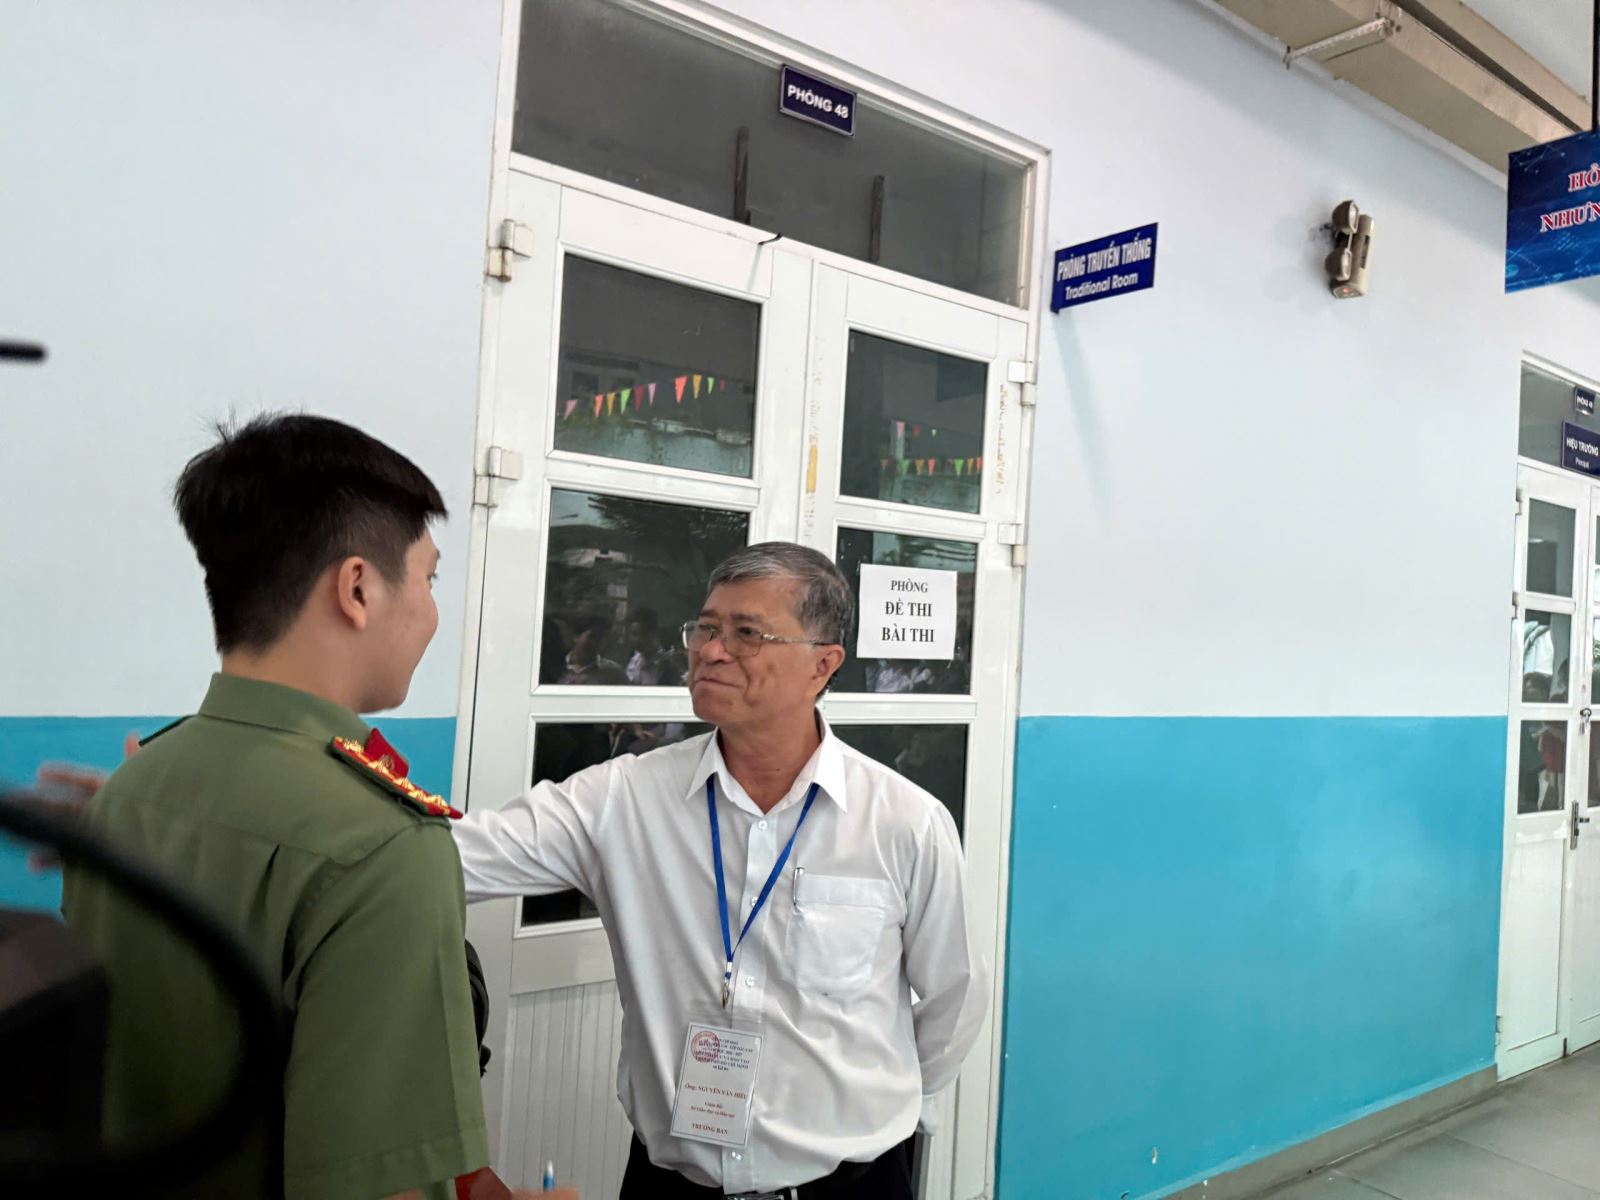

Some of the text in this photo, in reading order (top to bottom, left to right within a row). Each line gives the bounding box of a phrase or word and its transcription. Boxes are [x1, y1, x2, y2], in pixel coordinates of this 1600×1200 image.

[787, 84, 849, 119] PHÒNG 48
[1056, 253, 1086, 282] PHÒNG
[1121, 232, 1152, 265] THỐNG
[1065, 272, 1138, 300] Traditional Room
[890, 578, 928, 593] PHÒNG
[885, 597, 932, 617] ĐỀ THI
[881, 623, 934, 642] BÀI THI
